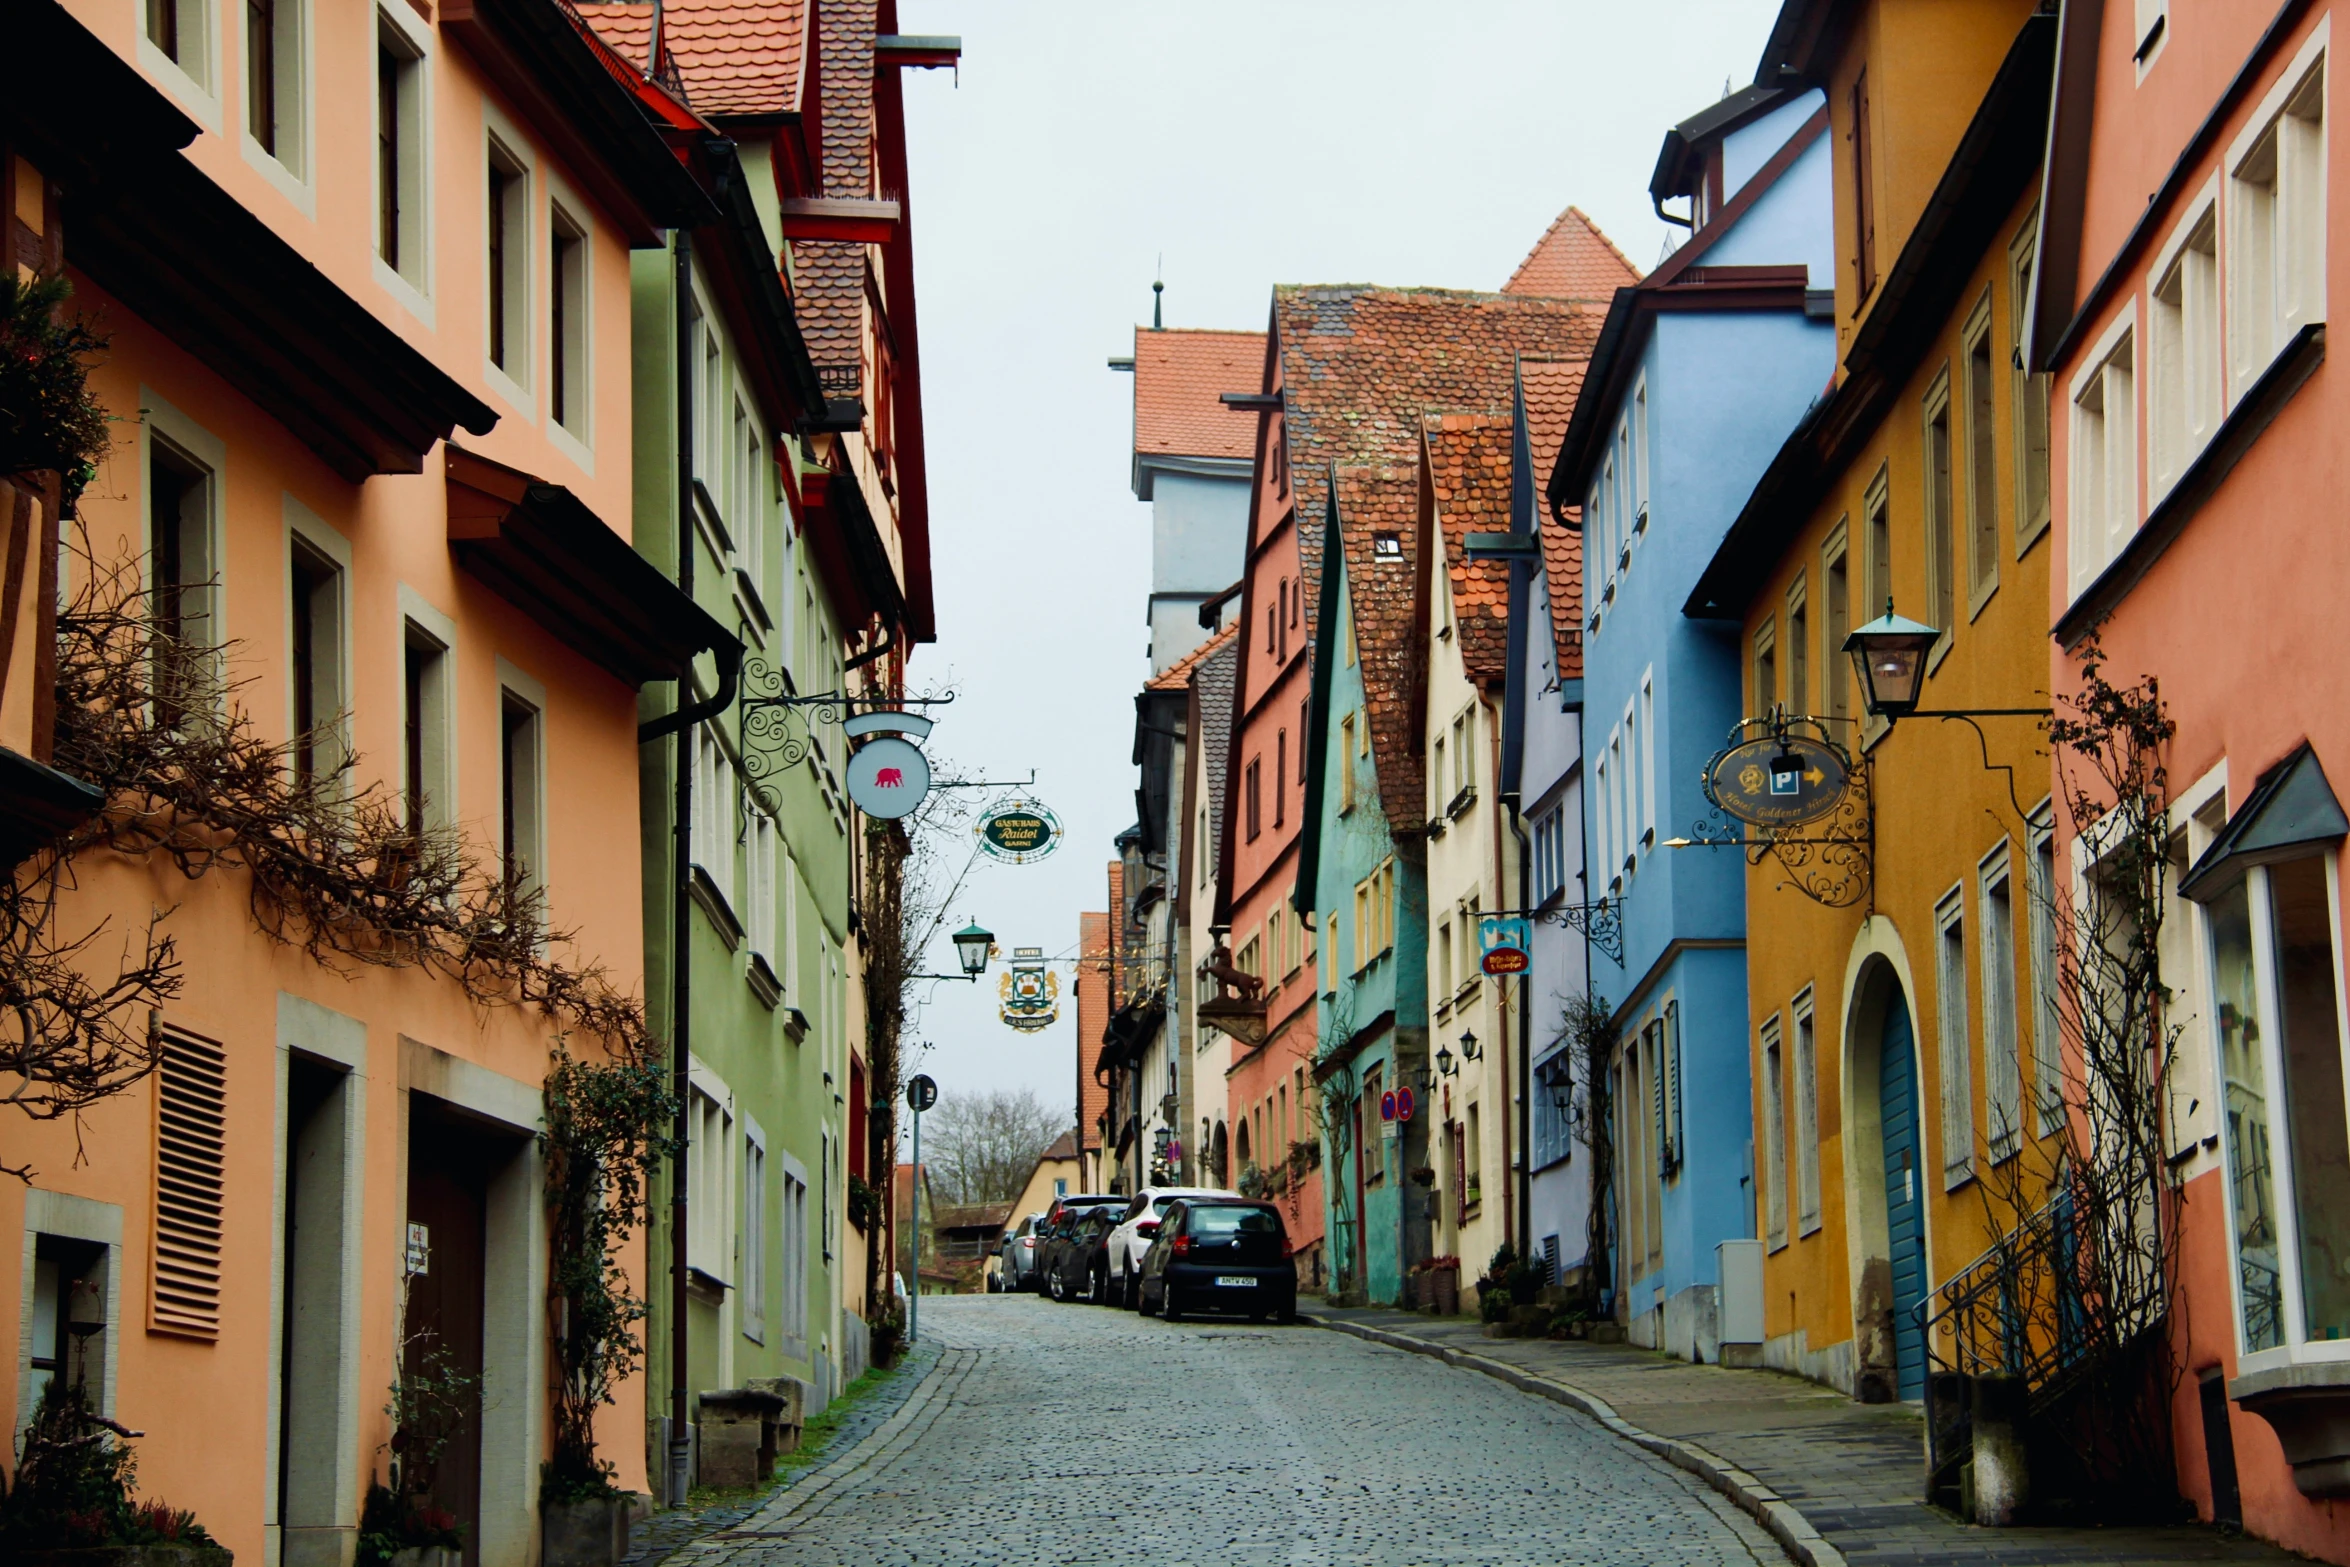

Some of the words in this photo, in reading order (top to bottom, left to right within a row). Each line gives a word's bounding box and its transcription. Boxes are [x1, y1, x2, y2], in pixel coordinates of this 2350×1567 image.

[1776, 771, 1792, 789] P
[1724, 791, 1755, 812] Hotel
[1757, 806, 1802, 818] Goldener
[1807, 788, 1837, 812] Hirsch
[997, 827, 1037, 839] Raidel
